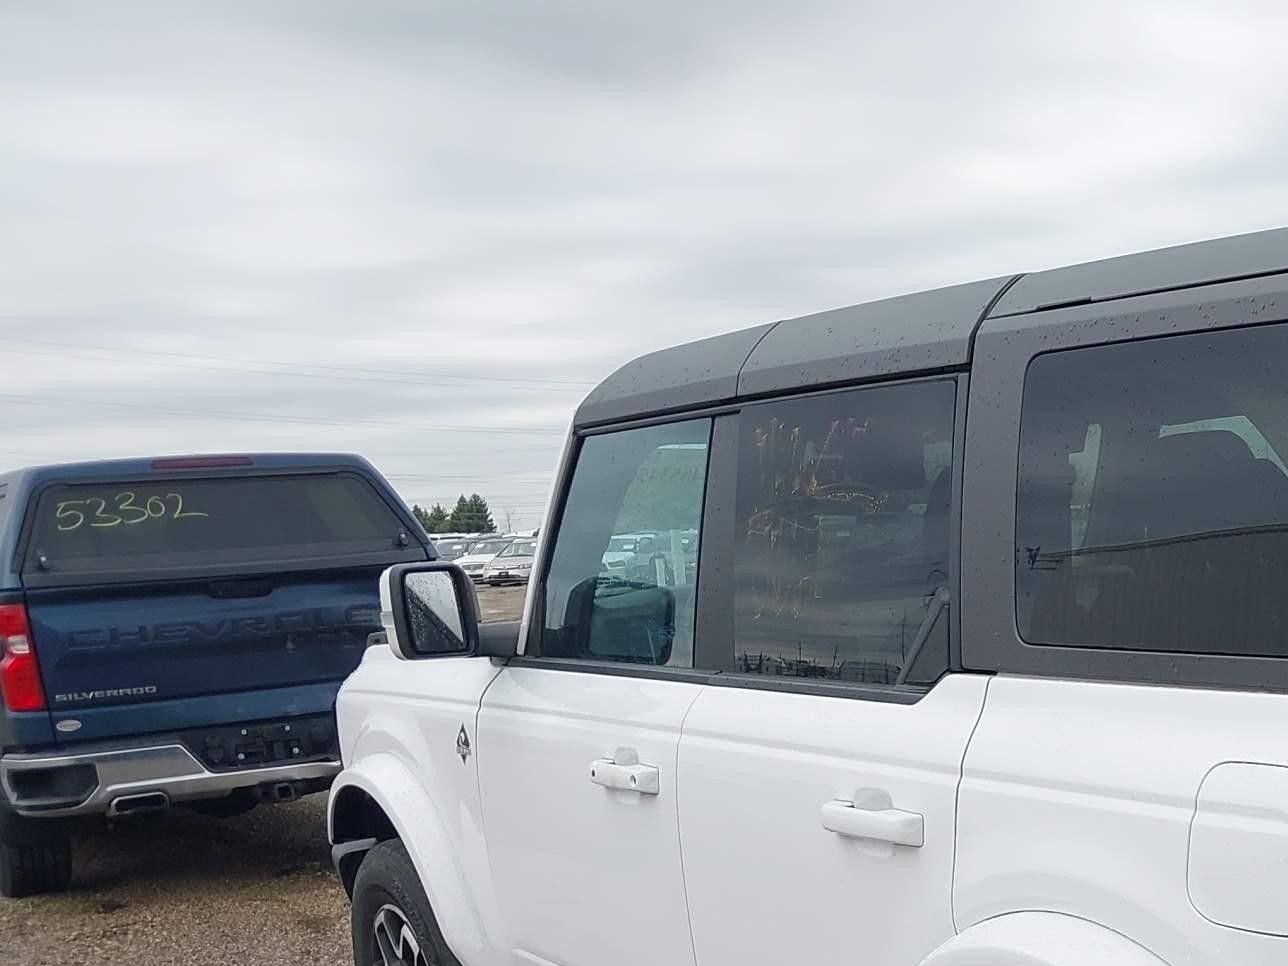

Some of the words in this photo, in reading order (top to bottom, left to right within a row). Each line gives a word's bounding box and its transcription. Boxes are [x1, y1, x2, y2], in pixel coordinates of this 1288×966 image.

[56, 491, 209, 531] 53302
[67, 604, 379, 651] CHEVROLE
[55, 685, 158, 702] SILVERADO
